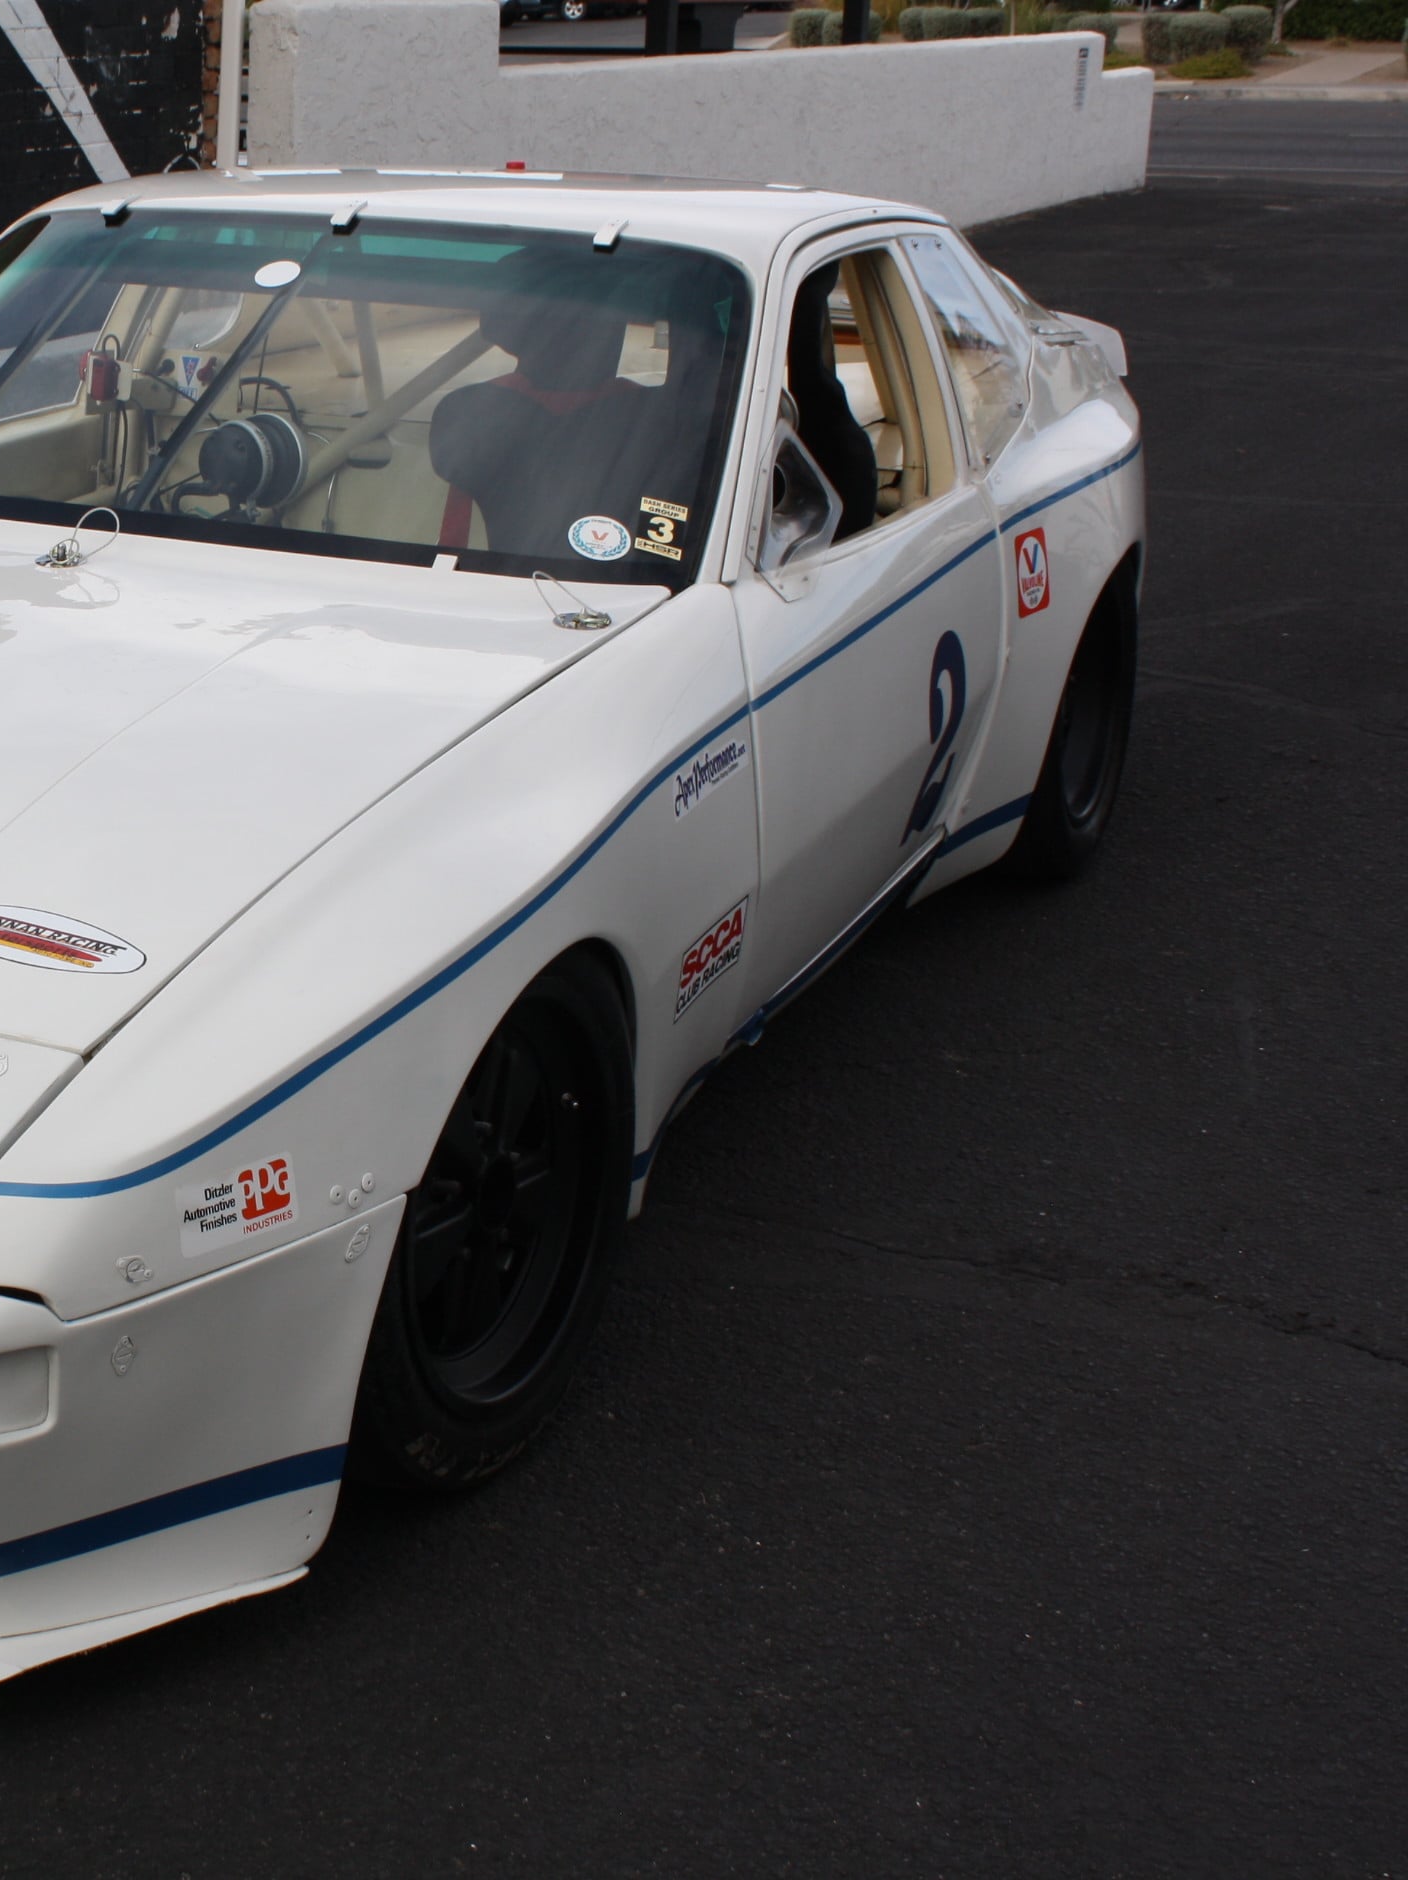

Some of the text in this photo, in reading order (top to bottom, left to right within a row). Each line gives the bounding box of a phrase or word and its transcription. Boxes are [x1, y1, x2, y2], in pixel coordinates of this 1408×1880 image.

[648, 506, 680, 518] GROUP
[663, 503, 686, 514] SERIES
[647, 516, 674, 544] 3
[1023, 544, 1038, 574] V
[899, 629, 966, 848] 2
[48, 928, 121, 955] RACING
[679, 906, 743, 990] SCCA
[675, 941, 742, 1015] CLUB RACING
[203, 1182, 234, 1201] Ditzler
[183, 1197, 237, 1224] Automotive
[199, 1211, 238, 1233] Finishes
[243, 1210, 294, 1235] INDUSTRIES
